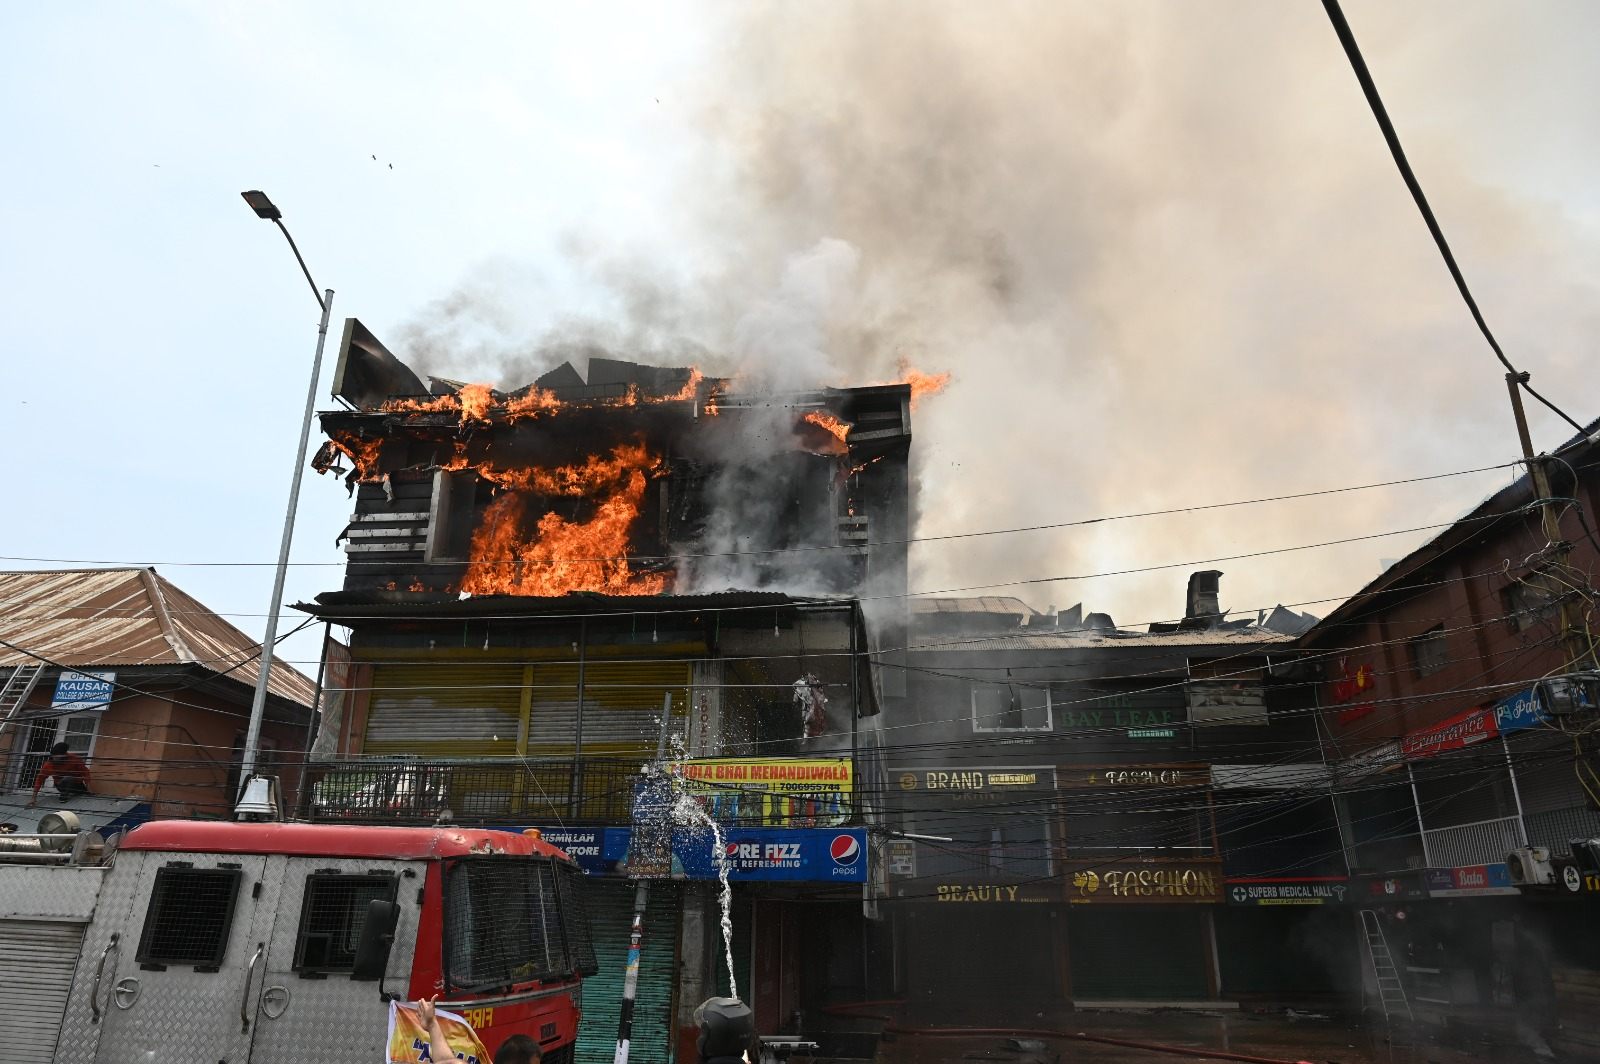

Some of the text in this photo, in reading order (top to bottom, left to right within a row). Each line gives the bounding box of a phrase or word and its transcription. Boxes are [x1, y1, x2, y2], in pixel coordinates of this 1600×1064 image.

[59, 683, 110, 691] KAUSAR
[56, 691, 77, 700] COLLEGE
[78, 691, 84, 700] OF
[1061, 709, 1174, 728] BAY LEAF
[716, 765, 748, 780] BHAI
[751, 765, 848, 780] MEHANDIWALA
[926, 772, 1036, 789] BRAND COLLECTION
[565, 846, 600, 856] STORE
[765, 843, 801, 859] FIZZ
[711, 859, 800, 868] MRE REFRESHING
[832, 867, 857, 876] pepsi
[1103, 869, 1216, 897] FASHION
[936, 884, 1019, 903] BEAUTY
[1248, 885, 1333, 898] SUPERB MEDICAL HALL
